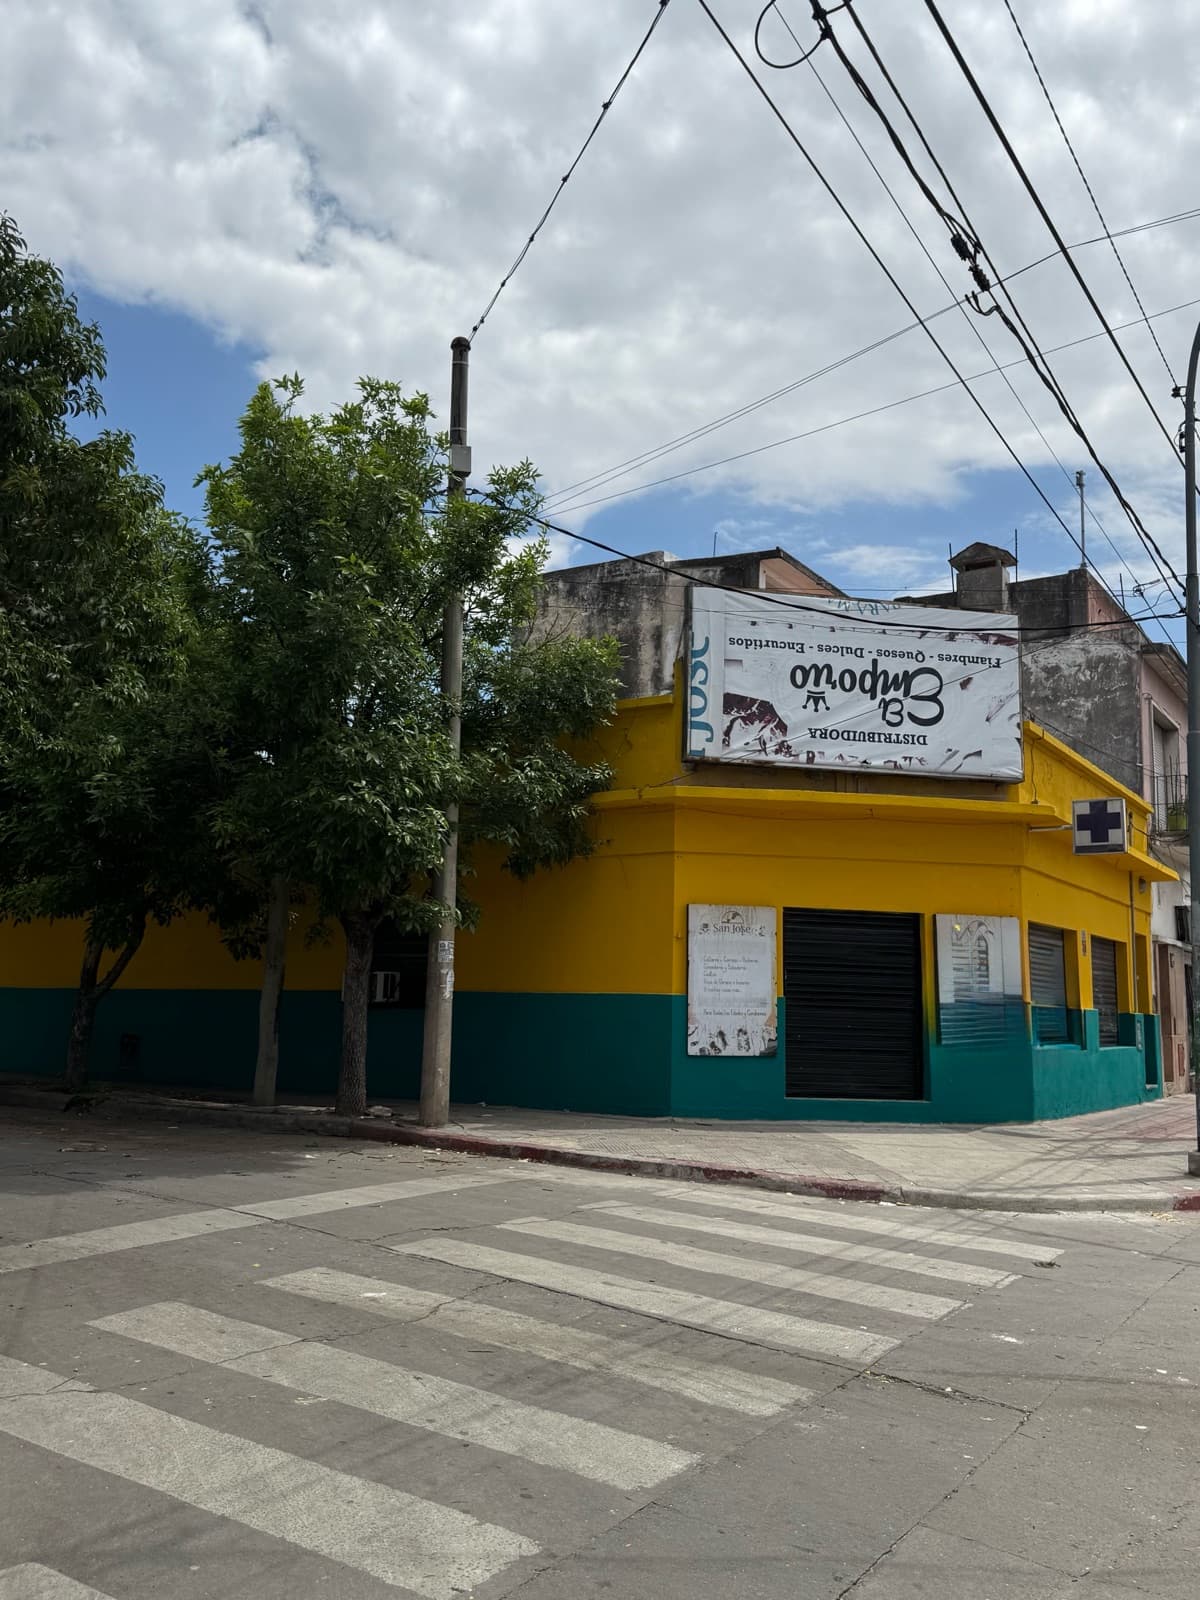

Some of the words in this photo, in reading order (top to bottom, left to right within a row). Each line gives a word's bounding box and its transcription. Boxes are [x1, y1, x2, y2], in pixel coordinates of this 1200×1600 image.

[728, 637, 806, 654] Encurtidos
[817, 644, 865, 658] Dulces
[876, 648, 926, 663] Quesos
[938, 653, 1002, 668] Fiambres
[790, 658, 944, 727] Emporio
[878, 697, 904, 727] El
[808, 727, 928, 746] DISTRIBUIDORA
[713, 924, 730, 933] San
